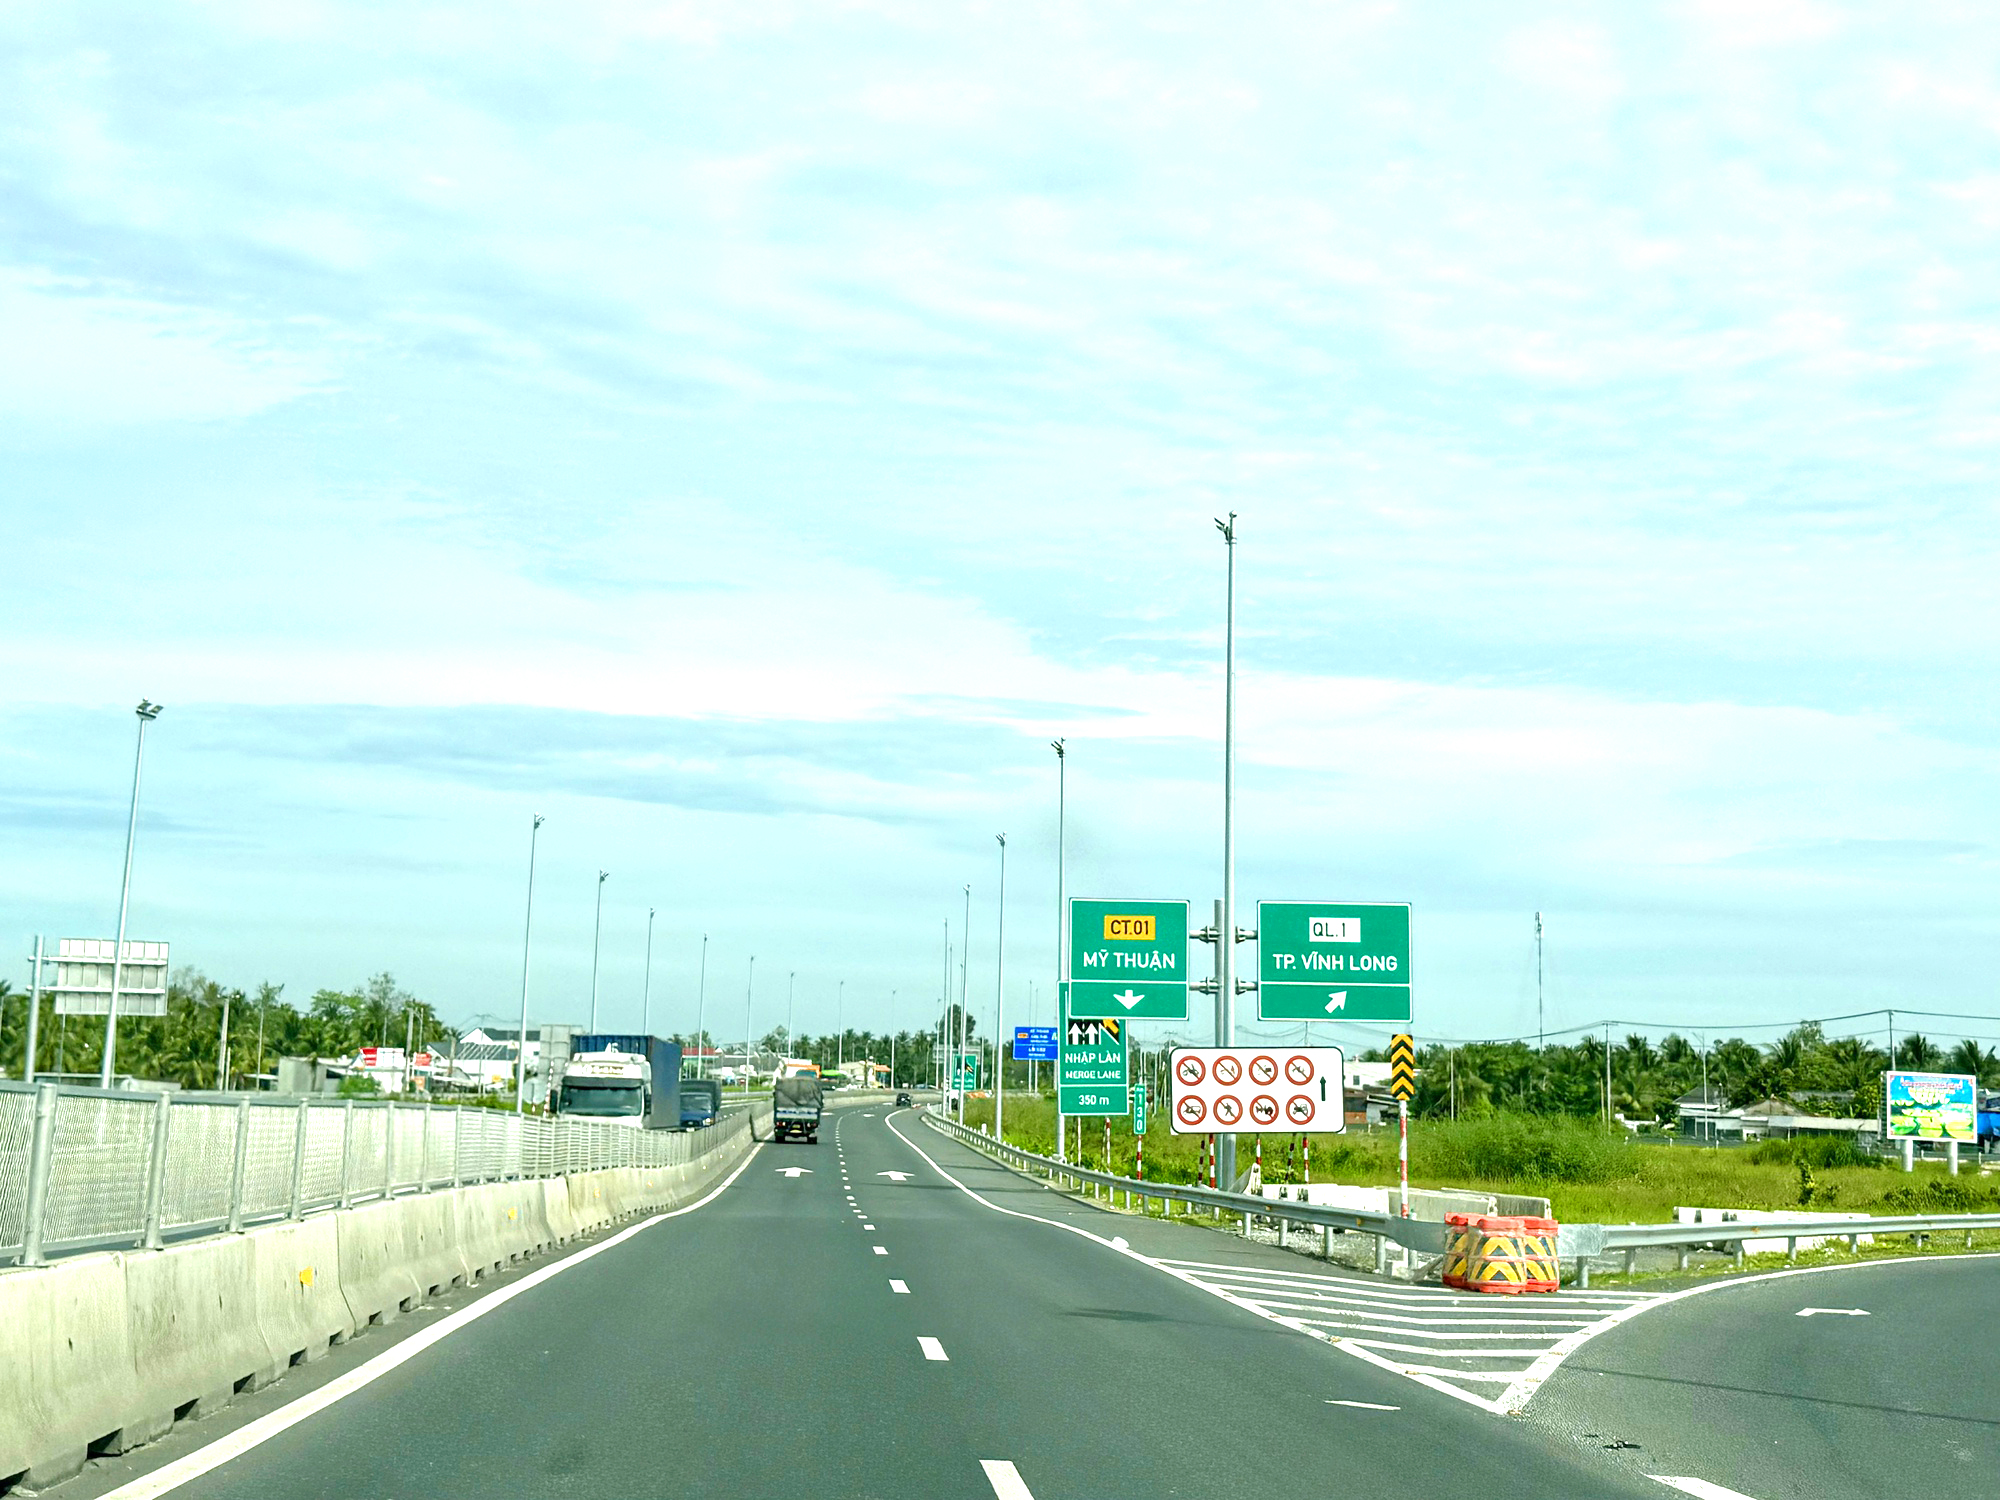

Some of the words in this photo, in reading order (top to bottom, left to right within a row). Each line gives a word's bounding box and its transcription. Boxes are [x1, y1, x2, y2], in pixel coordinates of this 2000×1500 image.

[1110, 919, 1149, 936] CT.01
[1312, 921, 1346, 938] QL.1
[1083, 948, 1109, 968] MỸ
[1112, 950, 1175, 972] THUẬN
[1272, 953, 1297, 970] TP.
[1301, 950, 1344, 971] VĨNH
[1349, 954, 1398, 971] LONG
[1064, 1051, 1096, 1065] NHẬP
[1098, 1050, 1120, 1063] LÀN
[1078, 1094, 1097, 1106] 350
[1099, 1096, 1110, 1106] m
